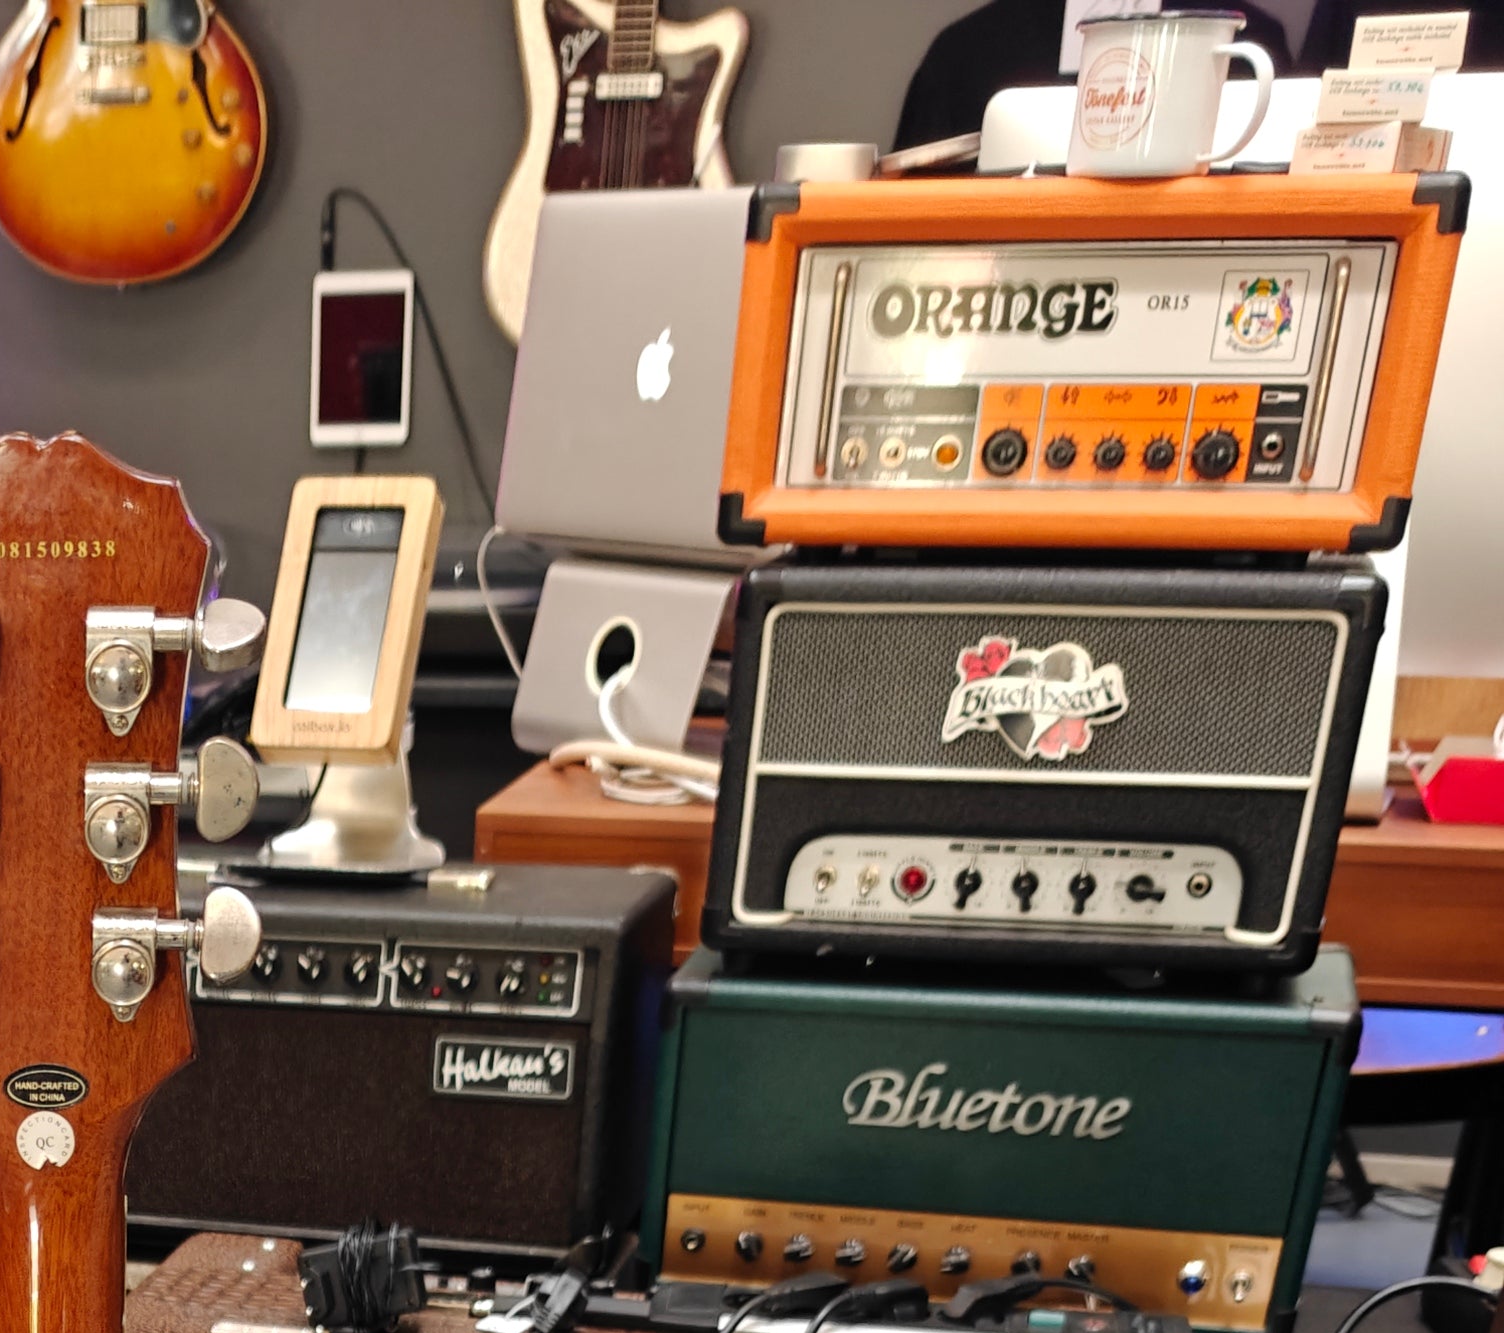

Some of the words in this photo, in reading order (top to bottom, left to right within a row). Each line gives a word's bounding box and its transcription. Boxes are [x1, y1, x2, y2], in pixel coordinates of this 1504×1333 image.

[869, 278, 1117, 341] ORANGE
[1147, 293, 1190, 311] OR15
[961, 676, 1114, 717] Blackheart
[14, 1081, 80, 1091] HAND-CRAFTED
[29, 1093, 37, 1102] IN
[39, 1093, 66, 1103] CHINA
[507, 1078, 552, 1094] MODEL
[843, 1062, 1132, 1141] Bluetone
[19, 1116, 62, 1161] INSPECTION
[36, 1136, 55, 1151] QC
